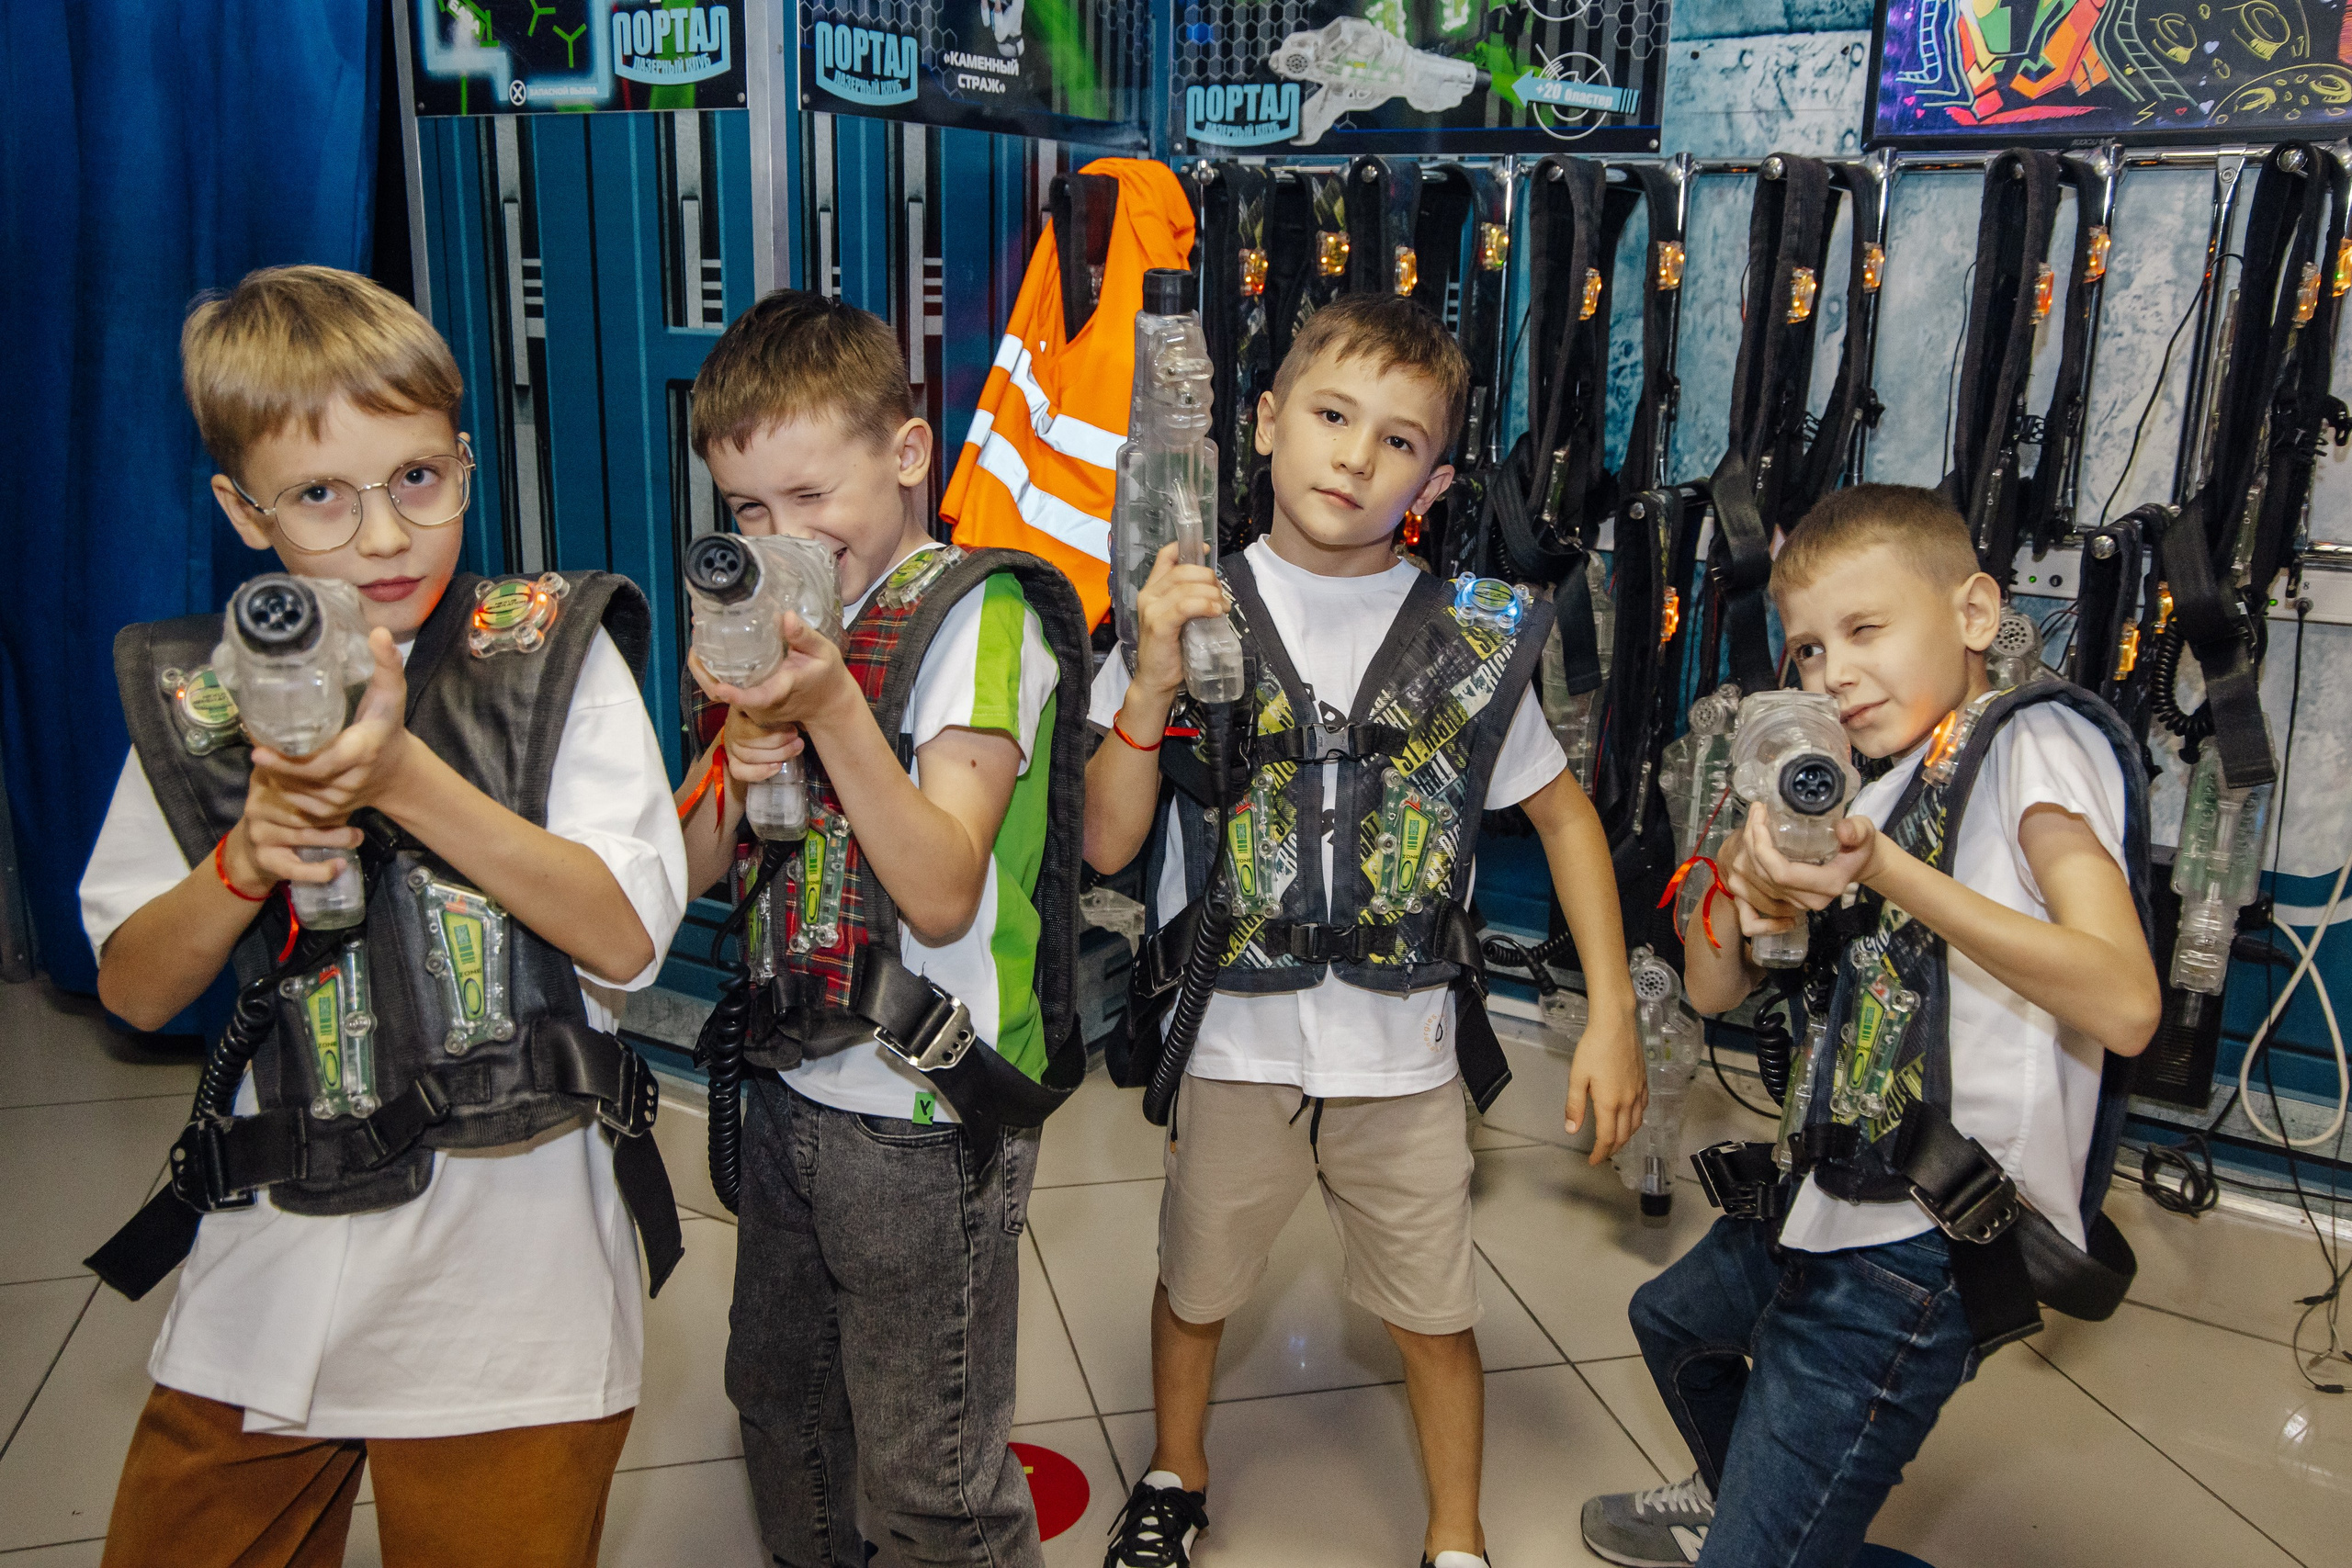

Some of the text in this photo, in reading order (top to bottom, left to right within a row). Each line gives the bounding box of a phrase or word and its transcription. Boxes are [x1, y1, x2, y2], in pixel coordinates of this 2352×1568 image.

[613, 6, 730, 56] ПОРТАЛ
[816, 21, 918, 79] ПОРТАЛ
[944, 51, 1019, 76] «КАМЕННЫЙ
[957, 73, 1006, 94] СТРАЖ»
[1535, 83, 1613, 107] +20 бластер
[1186, 83, 1299, 122] ПОРТАЛ
[459, 967, 482, 977] ZONE
